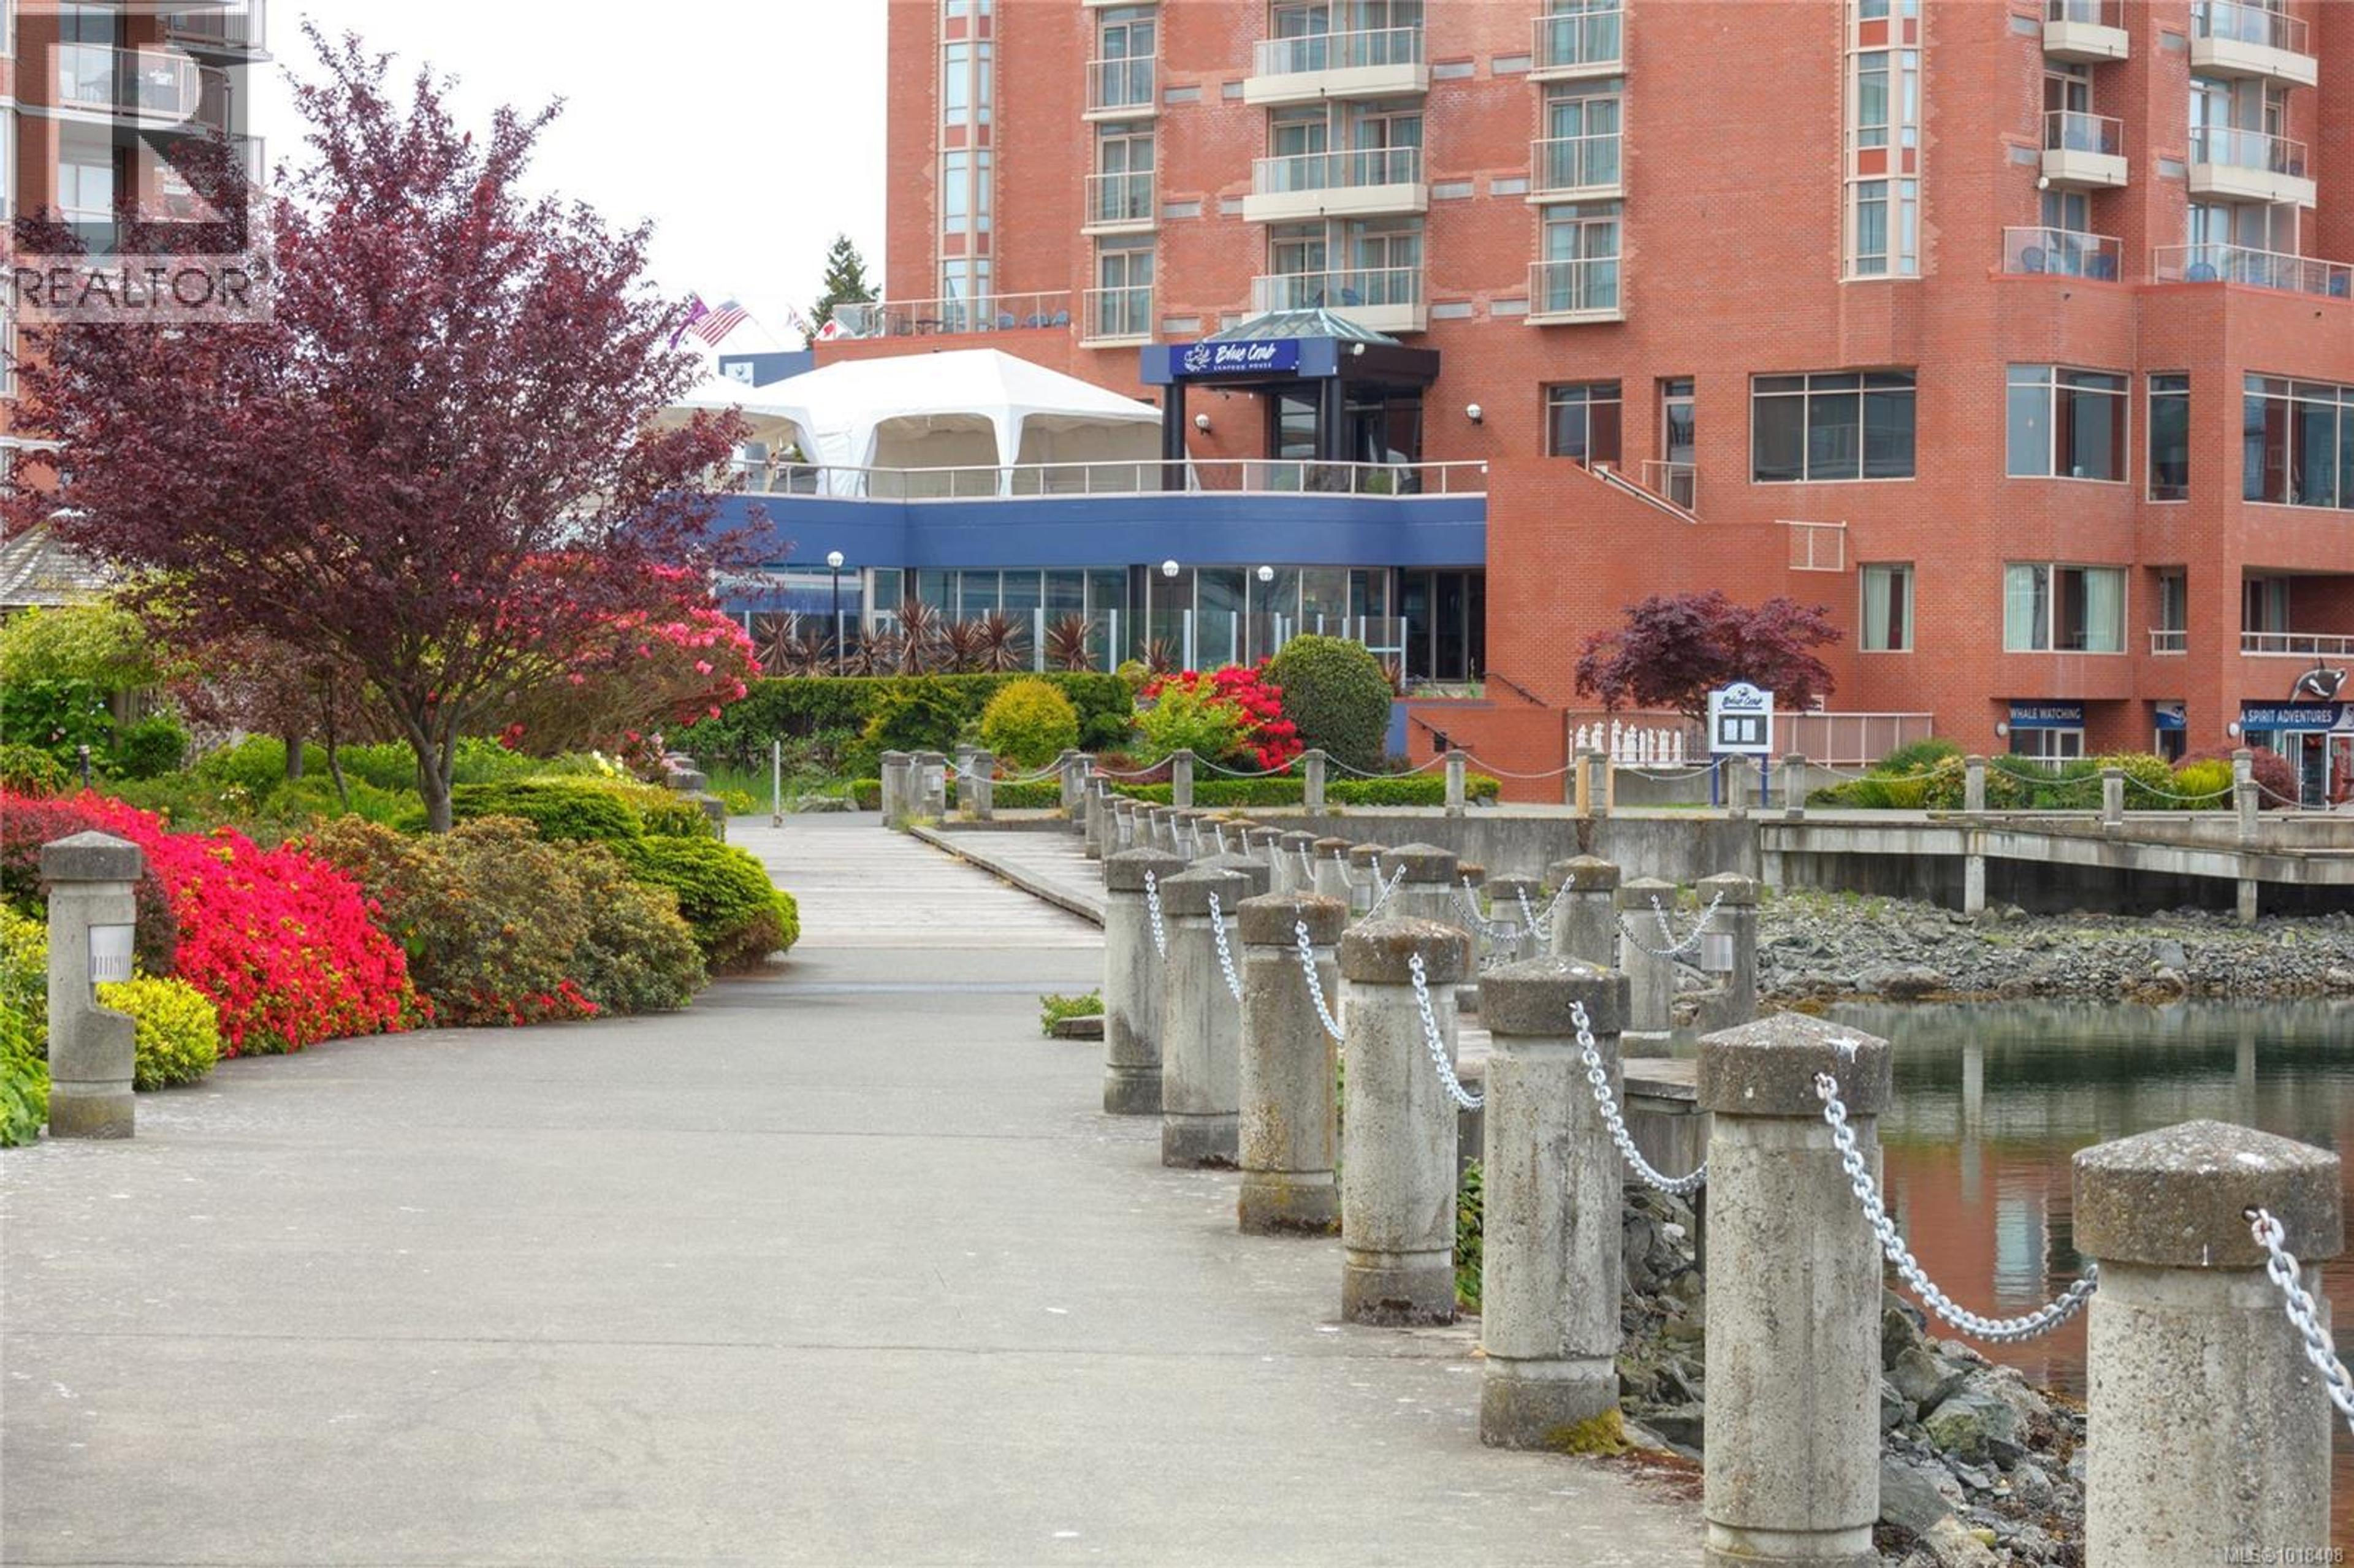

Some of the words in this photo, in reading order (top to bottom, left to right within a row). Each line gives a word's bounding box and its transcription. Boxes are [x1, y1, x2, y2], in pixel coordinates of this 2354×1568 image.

[1216, 344, 1246, 363] Blue
[1247, 343, 1276, 360] Crab
[2011, 707, 2037, 719] WHALE
[2040, 707, 2081, 719] WATCHING
[2248, 709, 2275, 723] SPIRIT
[2277, 709, 2333, 723] ADVENTURES
